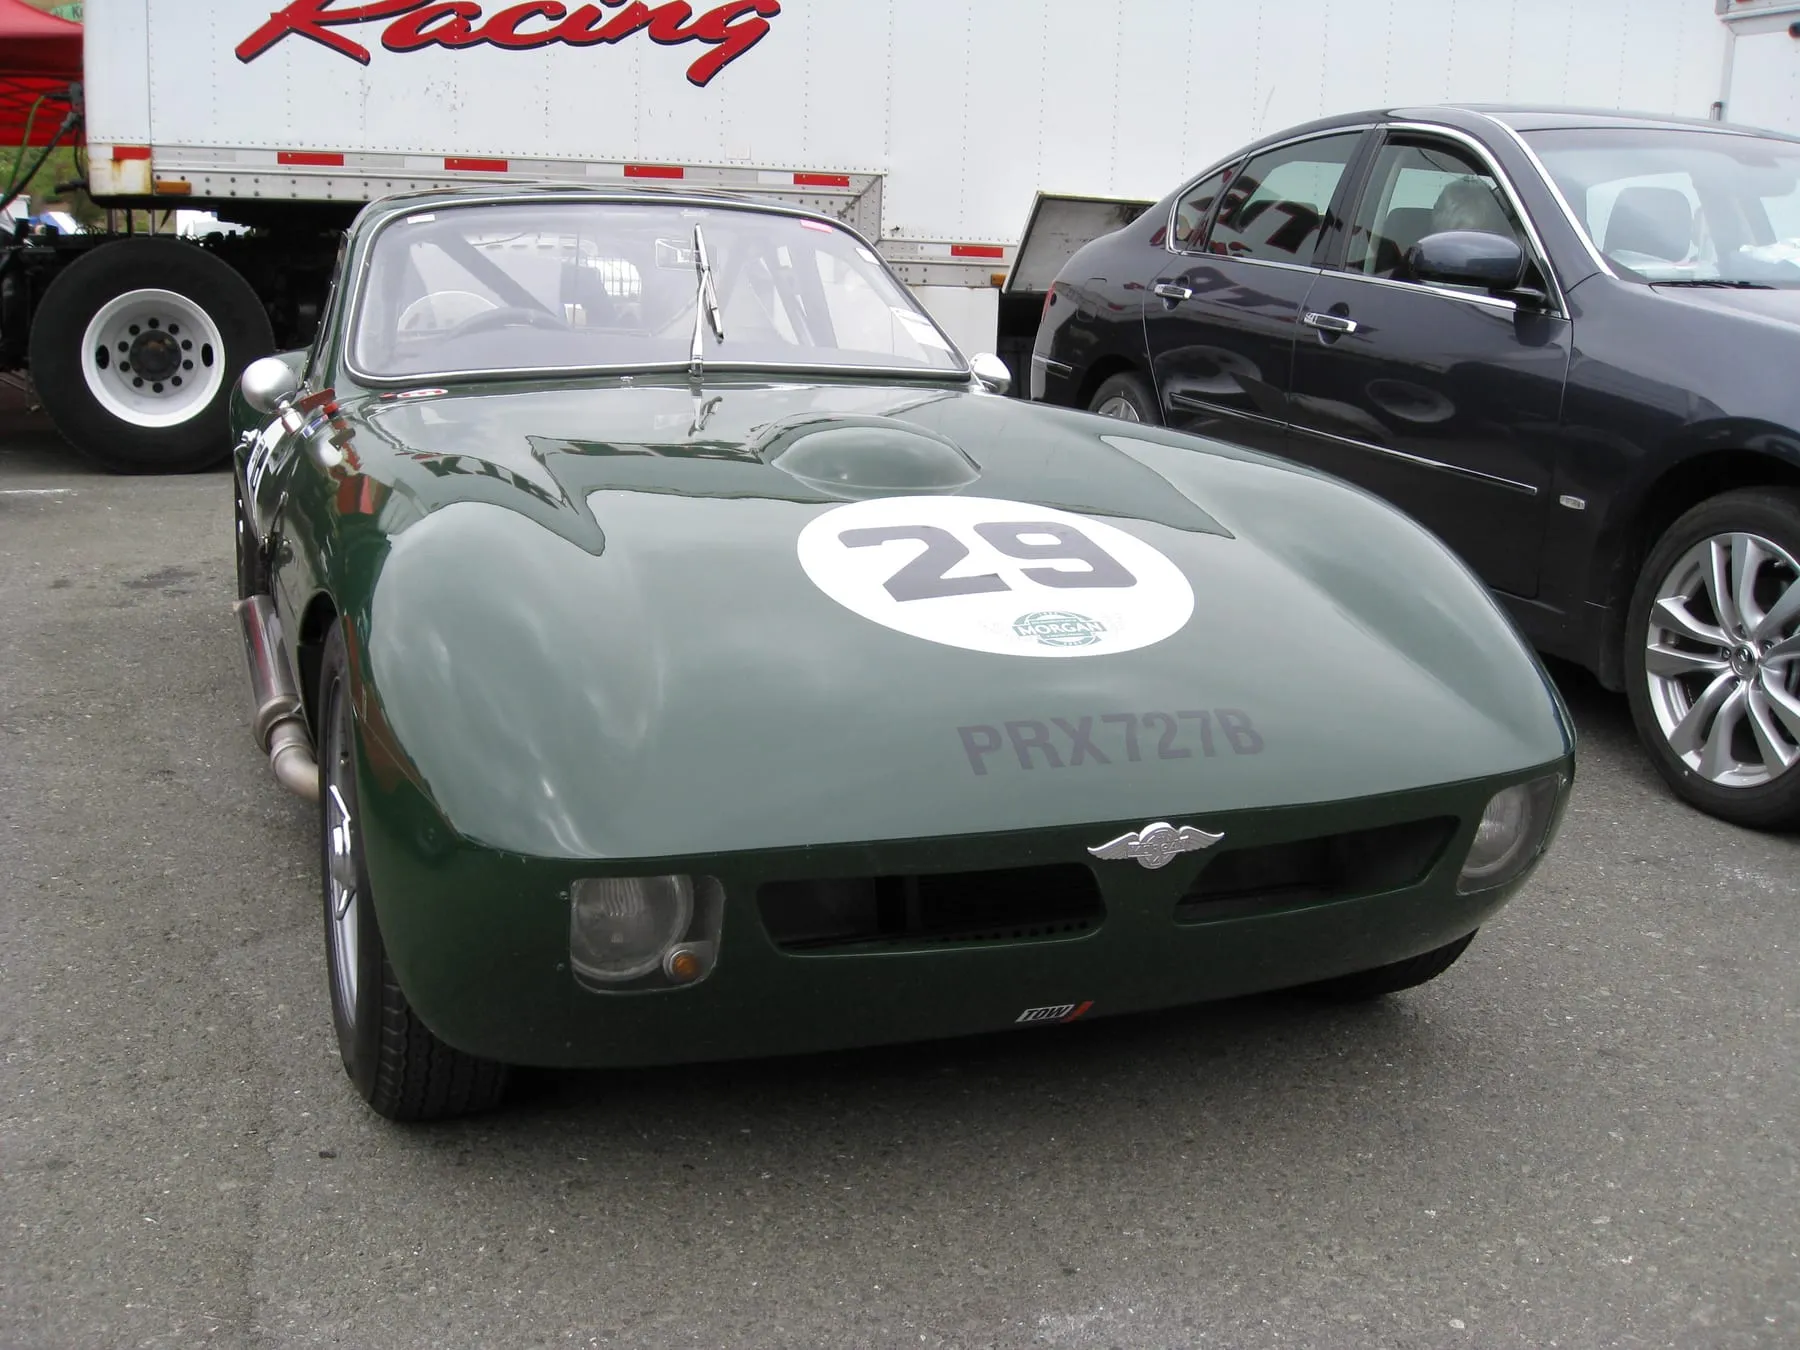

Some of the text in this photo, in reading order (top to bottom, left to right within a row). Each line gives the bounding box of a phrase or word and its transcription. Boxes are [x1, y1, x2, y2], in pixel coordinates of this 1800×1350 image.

[838, 522, 1137, 601] 29
[1017, 622, 1105, 636] MORGAN
[957, 708, 1264, 776] PRX727B
[1023, 1006, 1071, 1020] TOW
